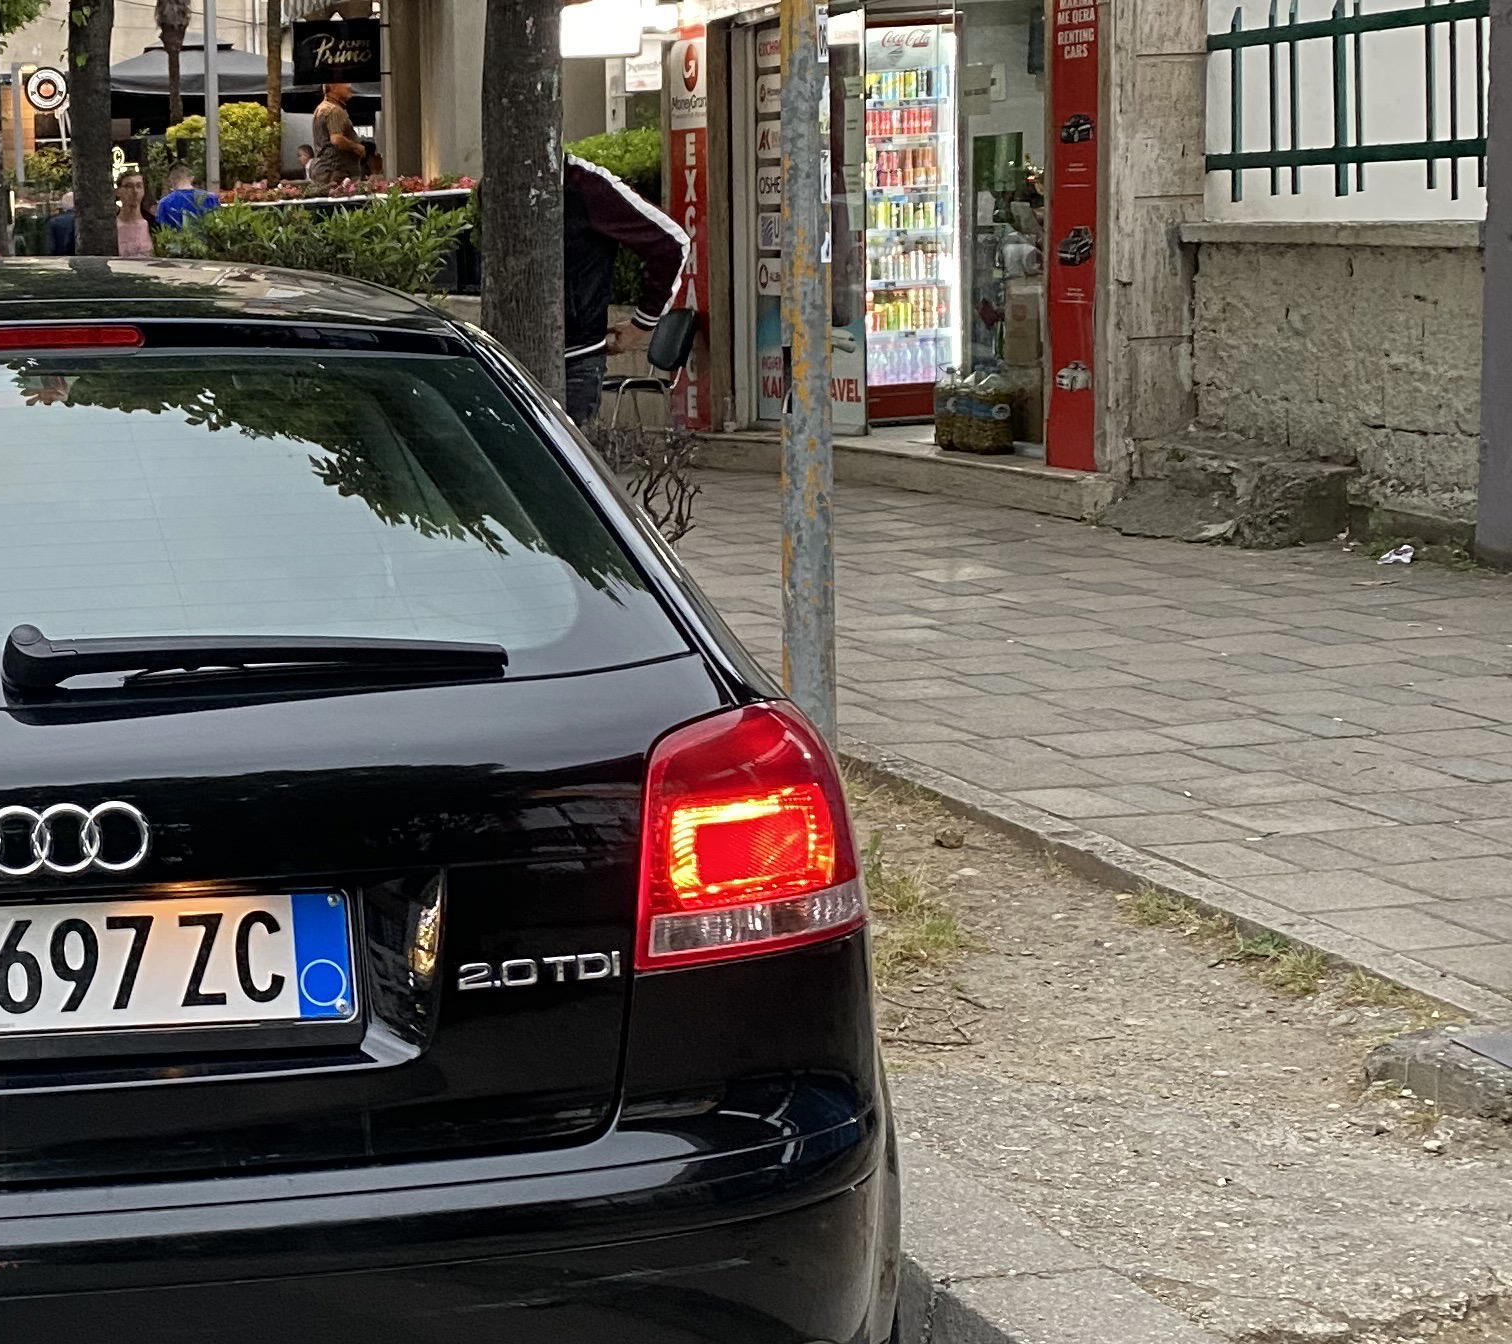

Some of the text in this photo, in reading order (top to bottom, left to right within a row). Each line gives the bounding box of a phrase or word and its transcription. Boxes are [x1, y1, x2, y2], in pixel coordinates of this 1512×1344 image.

[1057, 8, 1096, 26] ME QERA
[1057, 27, 1095, 46] RENTING
[1064, 43, 1089, 60] CARS
[830, 377, 862, 403] AVEL
[177, 910, 286, 1008] ZC
[458, 950, 621, 991] 2.0 TDI
